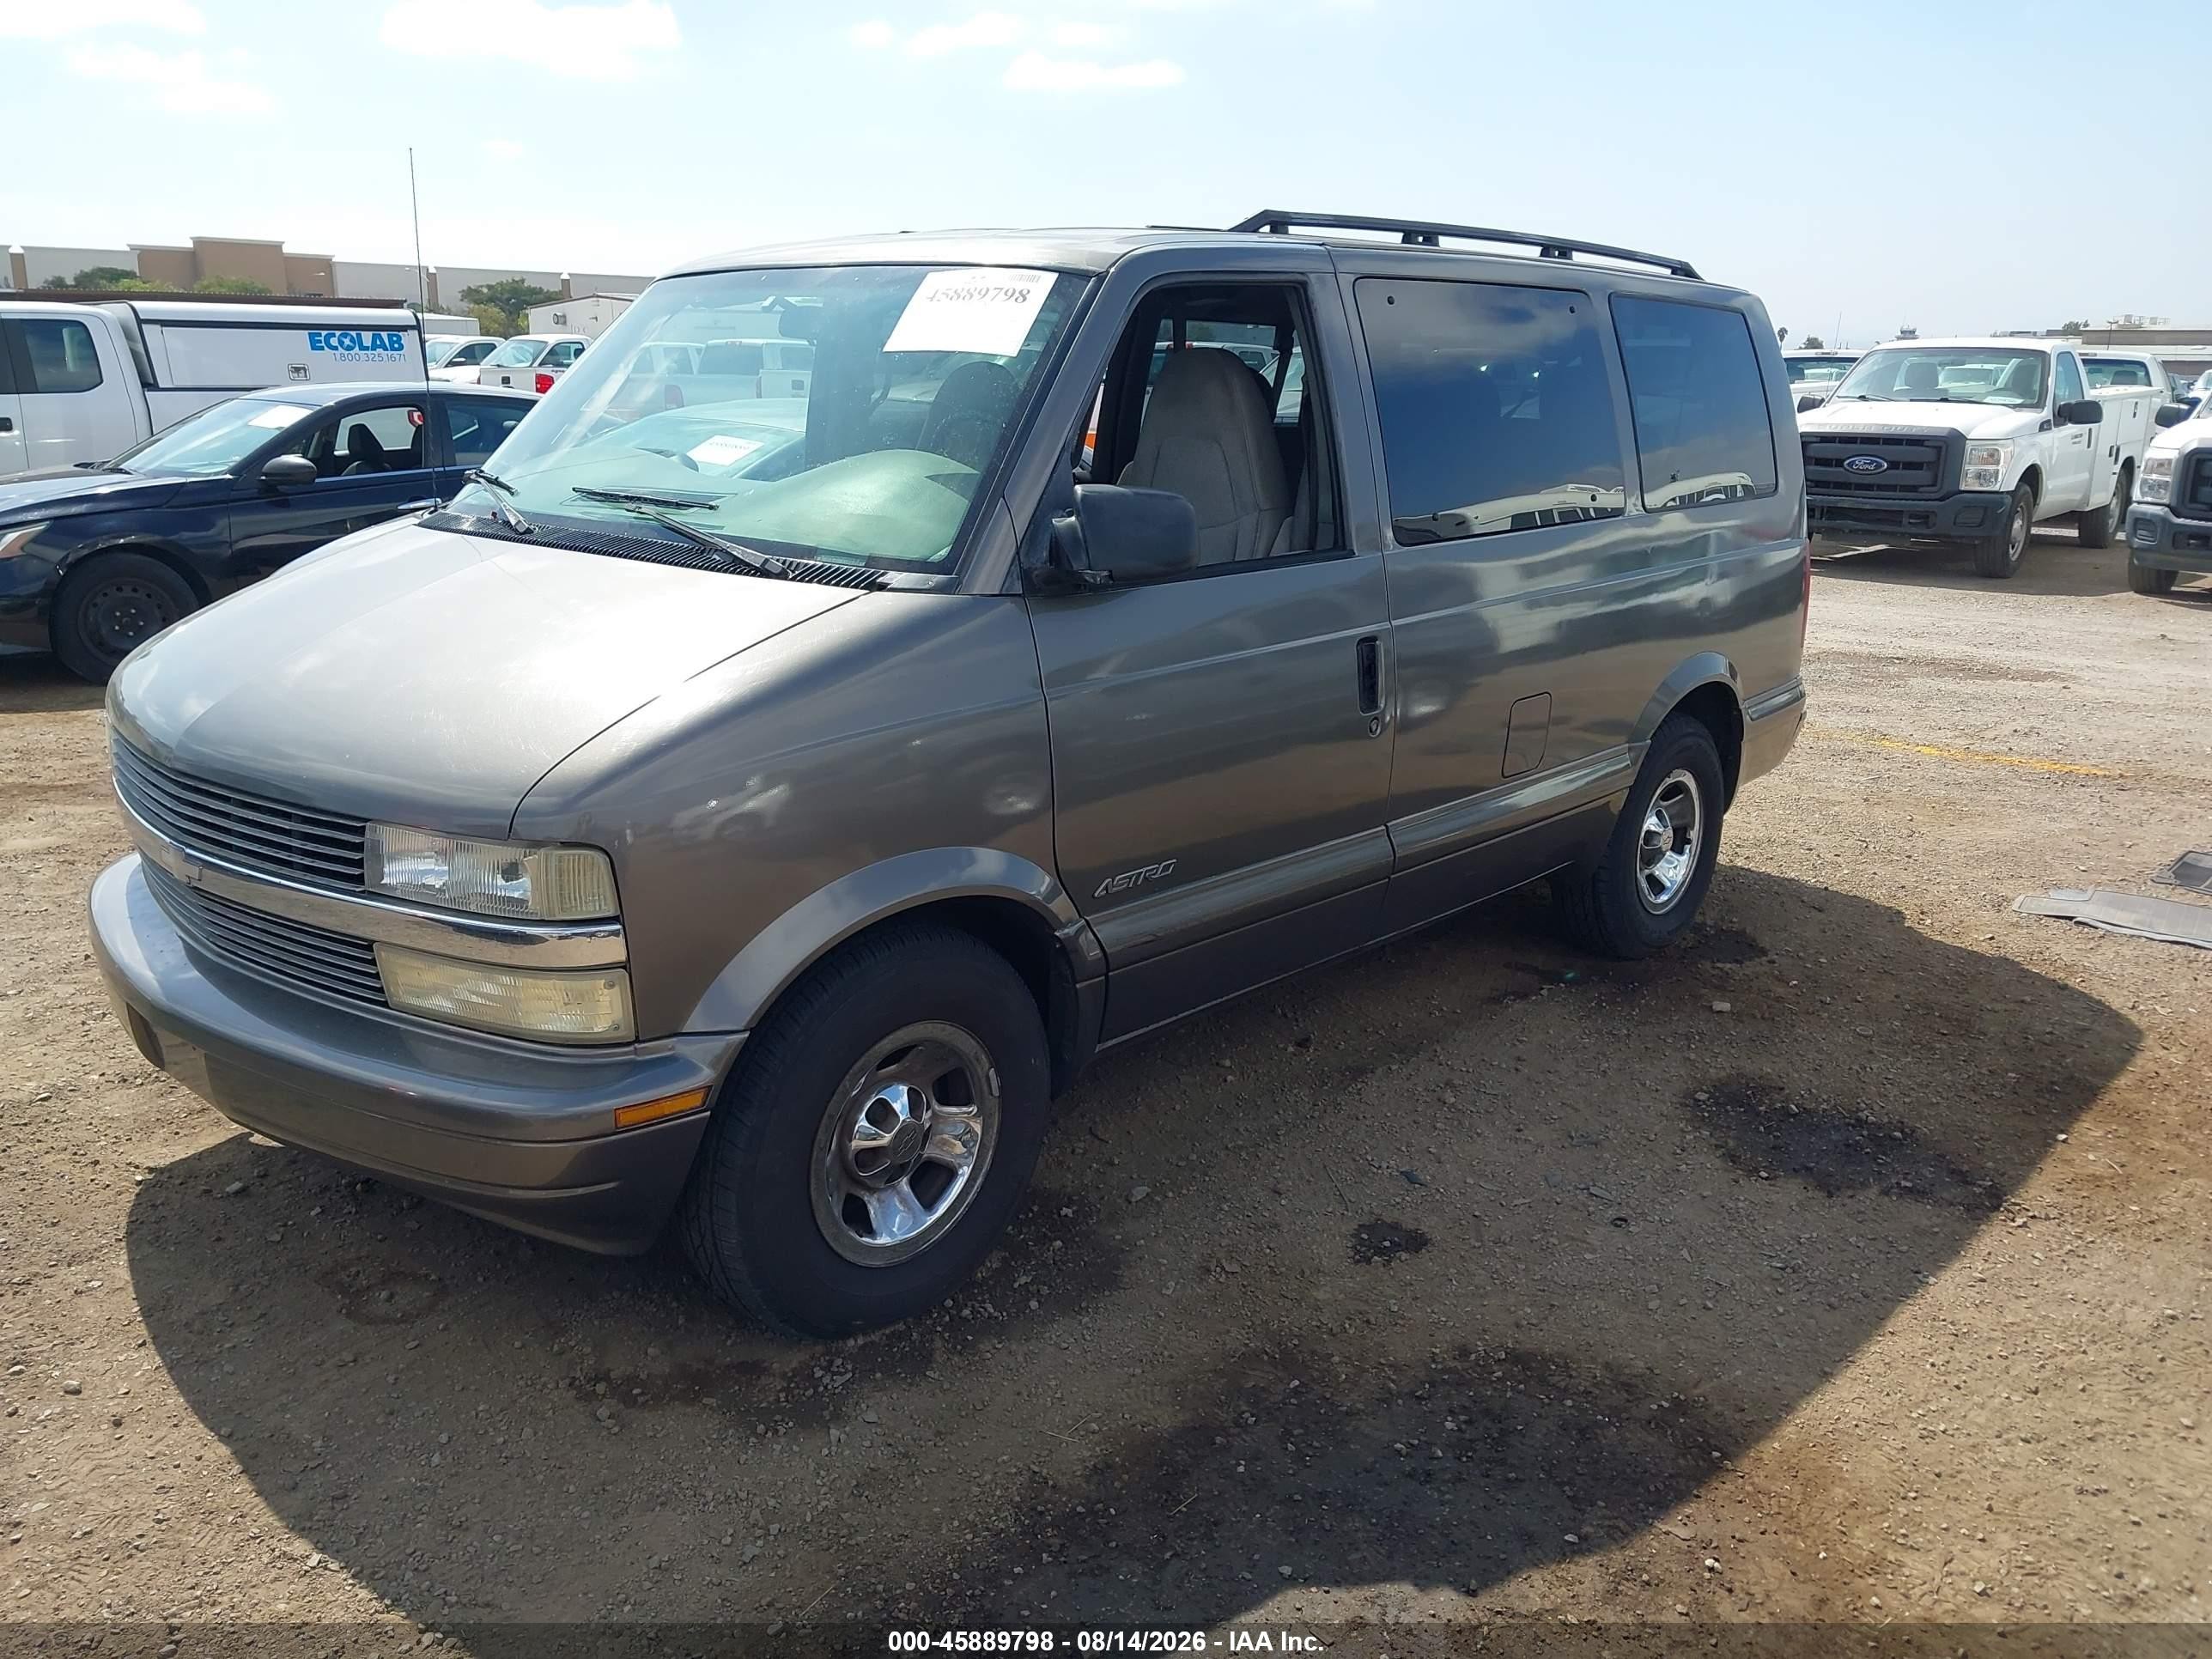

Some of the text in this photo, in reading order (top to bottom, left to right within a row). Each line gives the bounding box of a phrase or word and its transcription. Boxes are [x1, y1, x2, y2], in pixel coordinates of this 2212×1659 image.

[307, 331, 405, 352] ECOLAB
[1852, 459, 1876, 471] Ford
[1093, 859, 1178, 898] ASTRO
